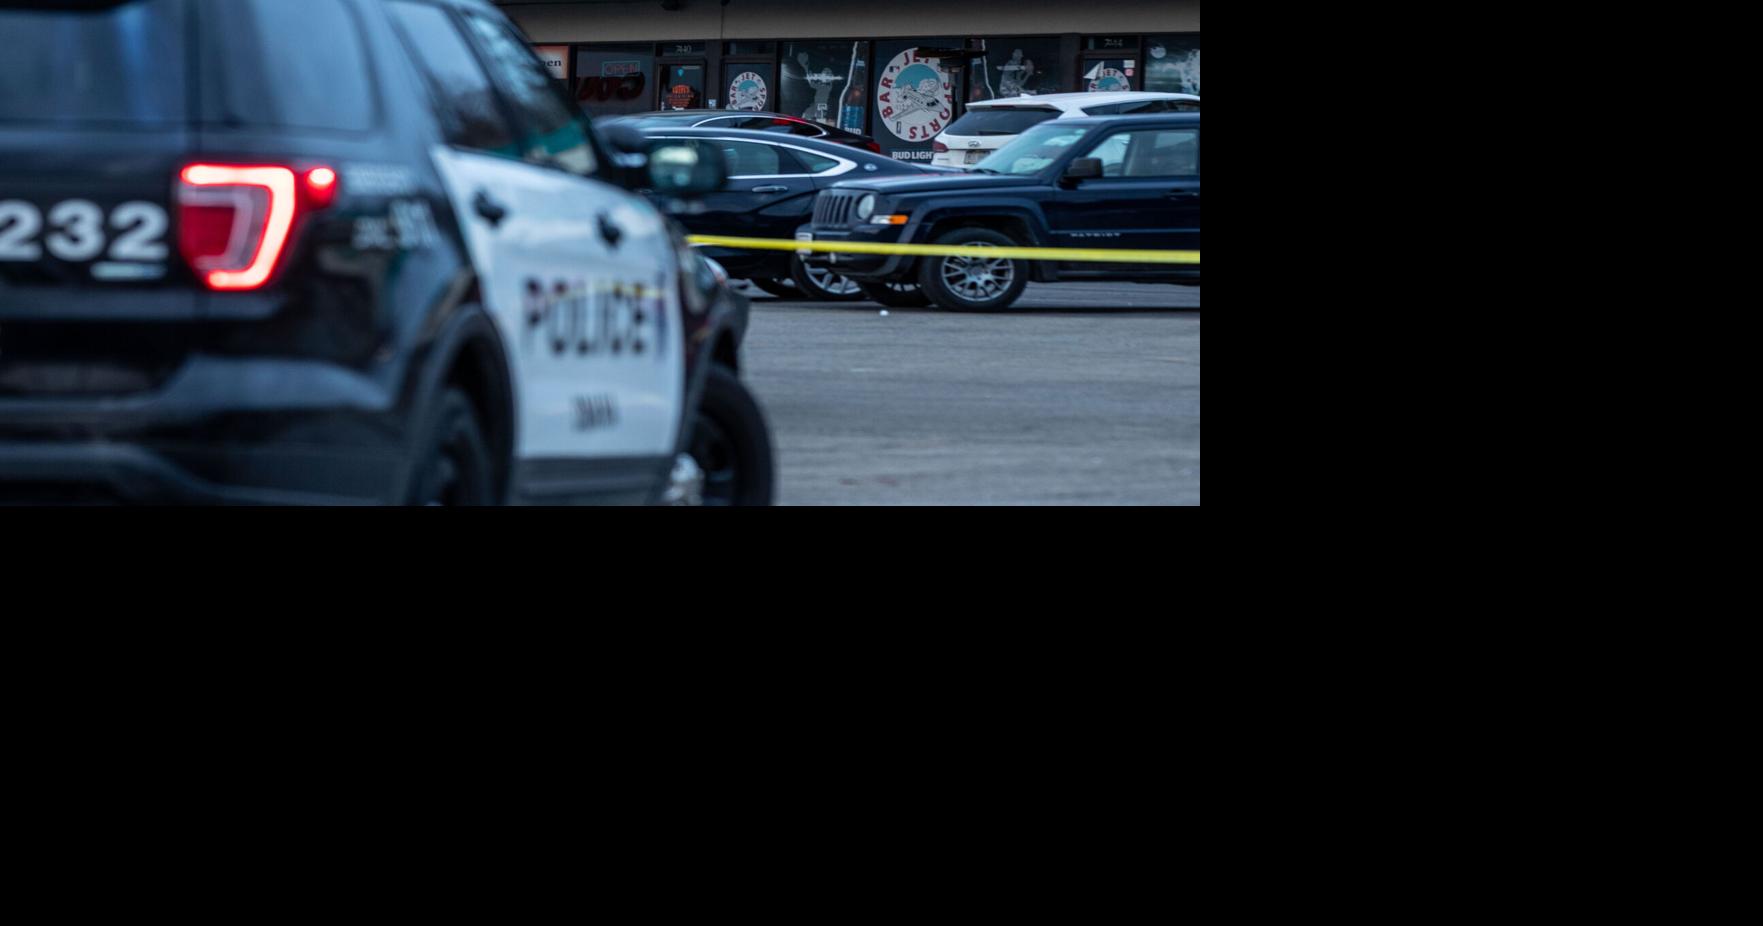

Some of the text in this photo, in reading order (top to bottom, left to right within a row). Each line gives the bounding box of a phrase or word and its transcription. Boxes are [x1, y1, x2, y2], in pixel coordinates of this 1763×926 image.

[879, 77, 893, 119] BAR
[892, 151, 910, 160] BUD
[0, 200, 169, 262] 232
[524, 277, 649, 358] POLICE
